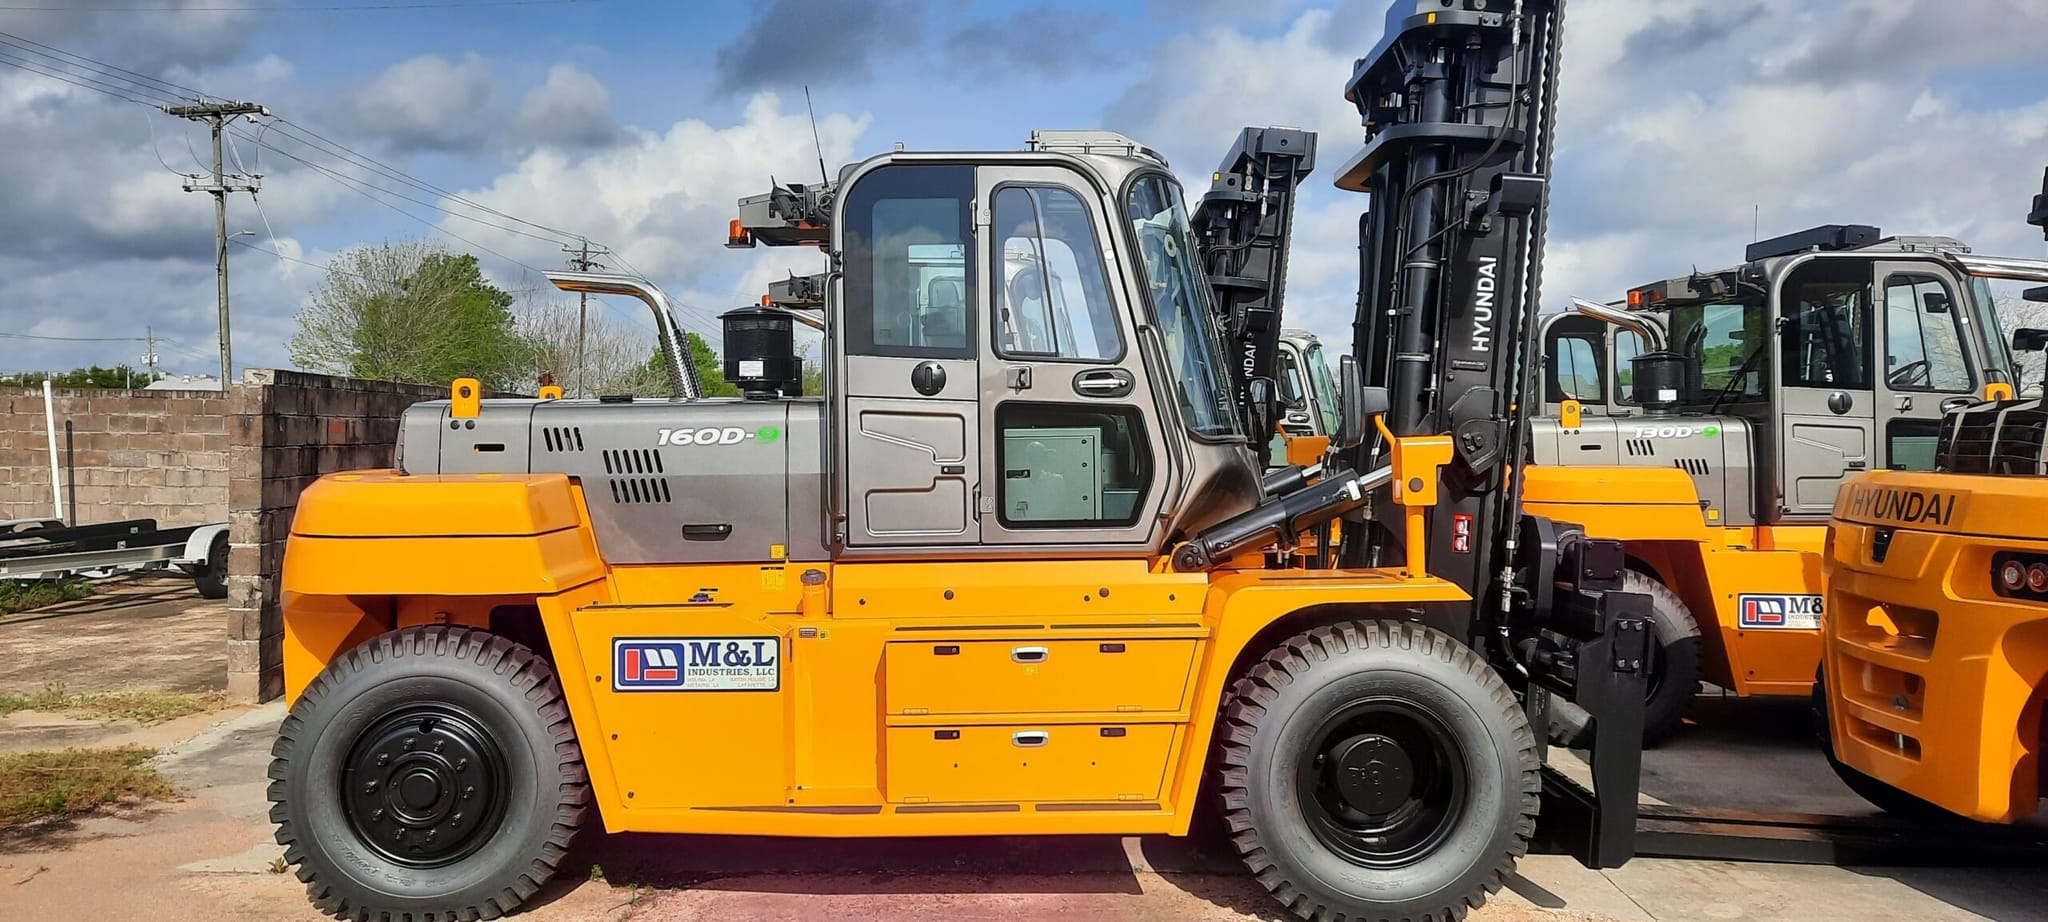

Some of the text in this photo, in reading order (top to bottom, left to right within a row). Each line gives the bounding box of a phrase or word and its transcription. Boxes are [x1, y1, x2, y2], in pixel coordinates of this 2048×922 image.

[1471, 256, 1497, 352] HYUNDAI
[656, 425, 782, 446] 160D-9
[1634, 425, 1719, 439] 130D-9
[1851, 487, 1956, 526] HYUNDAI
[1788, 597, 1824, 614] M&
[688, 641, 775, 667] M&L
[687, 668, 775, 677] INDUSTRIES, LLC
